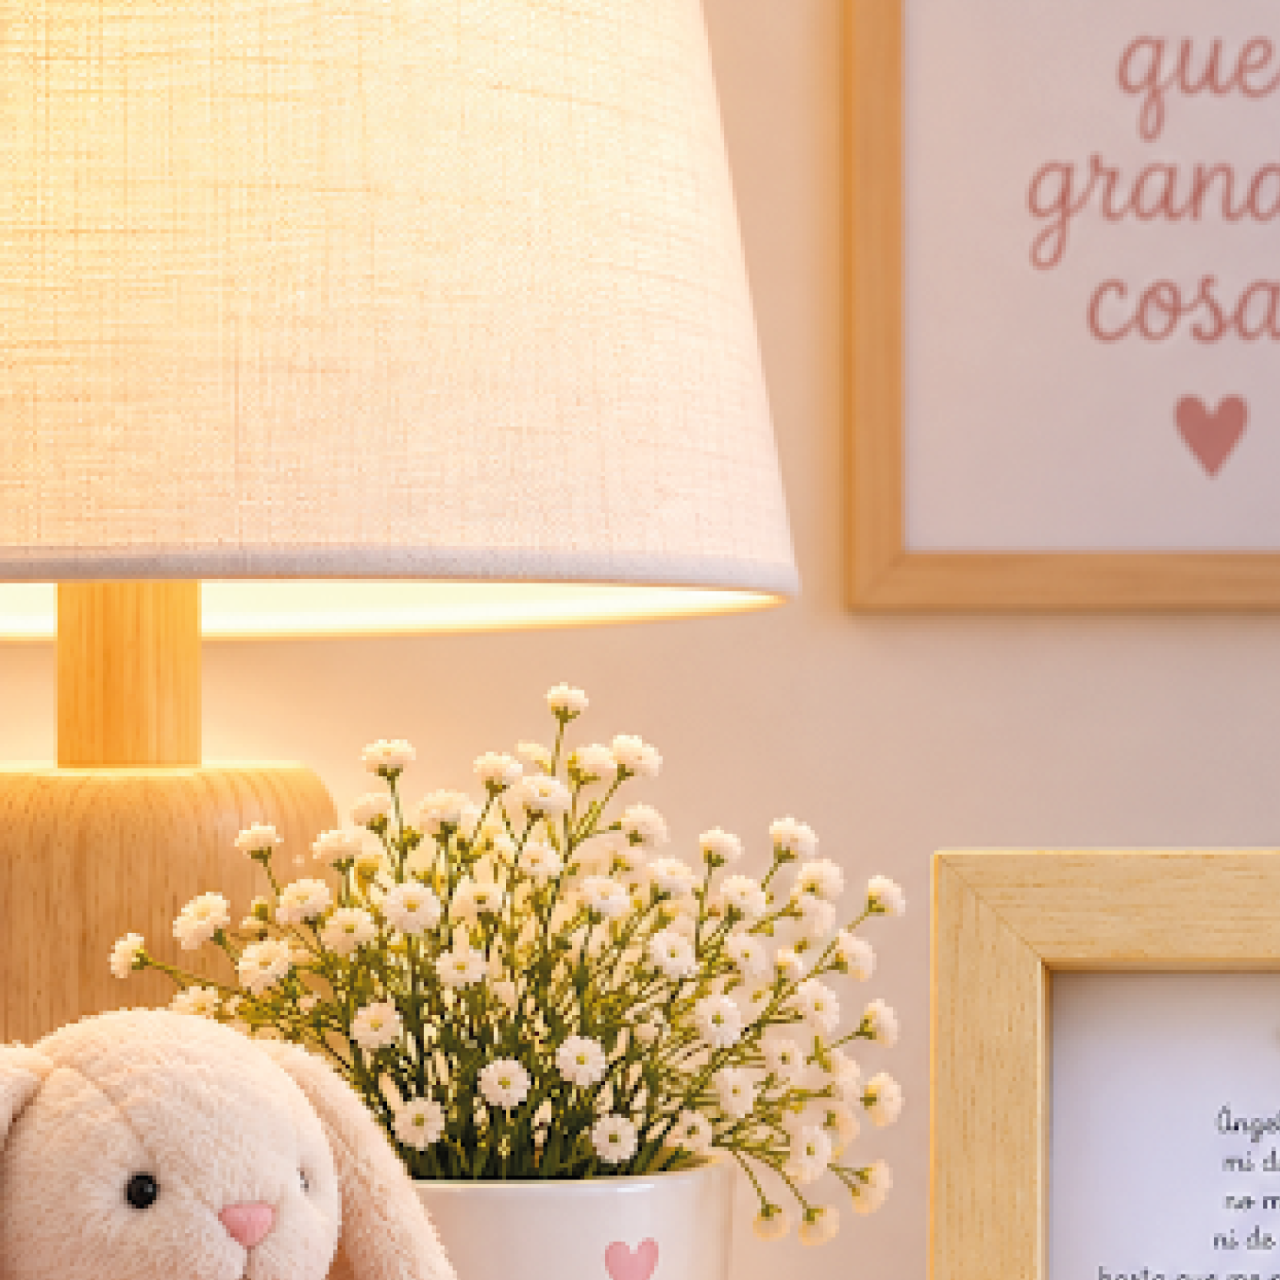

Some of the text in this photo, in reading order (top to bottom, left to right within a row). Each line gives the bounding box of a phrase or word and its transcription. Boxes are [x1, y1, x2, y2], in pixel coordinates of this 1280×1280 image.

[1222, 1150, 1255, 1173] mi
[1223, 1195, 1255, 1211] no
[1213, 1228, 1239, 1251] ni
[1246, 1224, 1277, 1251] de
